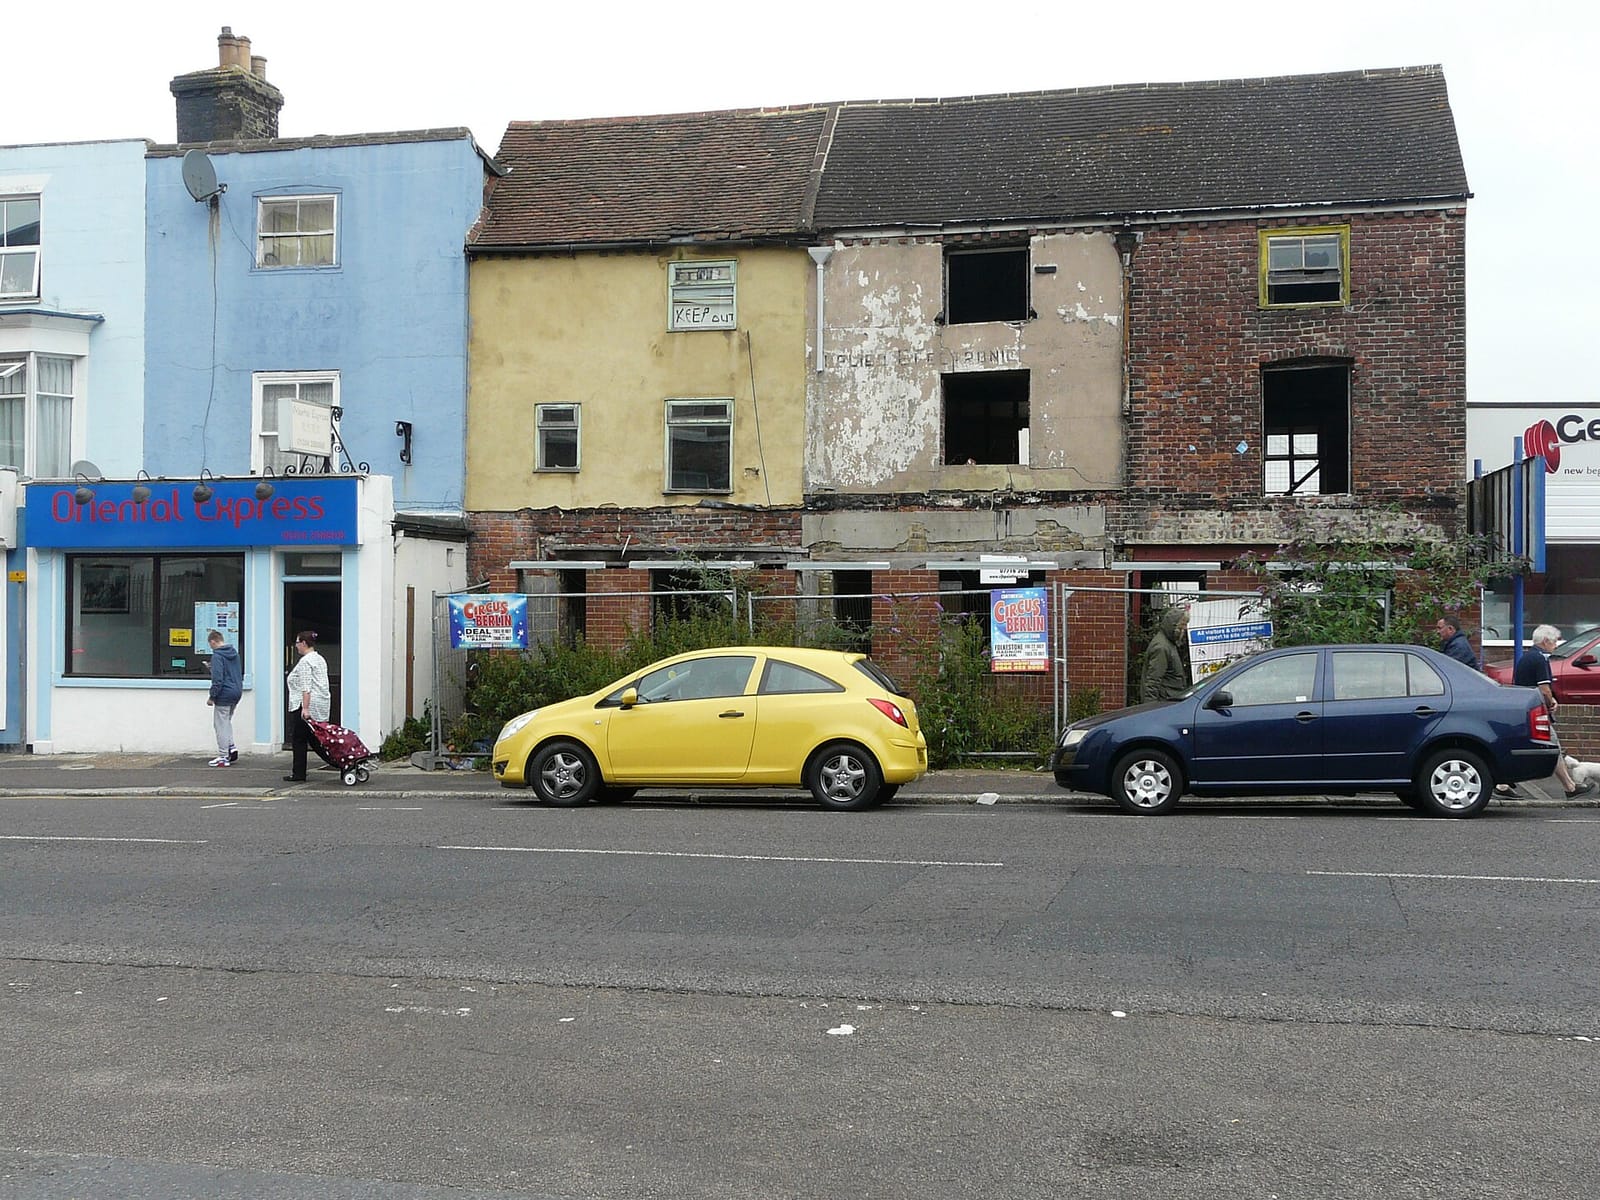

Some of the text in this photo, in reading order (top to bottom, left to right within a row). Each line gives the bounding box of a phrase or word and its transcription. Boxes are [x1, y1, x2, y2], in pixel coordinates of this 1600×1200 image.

[676, 307, 734, 323] KEEP OUT
[52, 489, 325, 529] Oriental Express
[464, 602, 509, 619] CIRCUS
[994, 598, 1040, 622] CIRCUS
[476, 615, 512, 627] BERLIN
[1006, 616, 1045, 632] BERLIN
[995, 643, 1023, 651] FOLKESTONE
